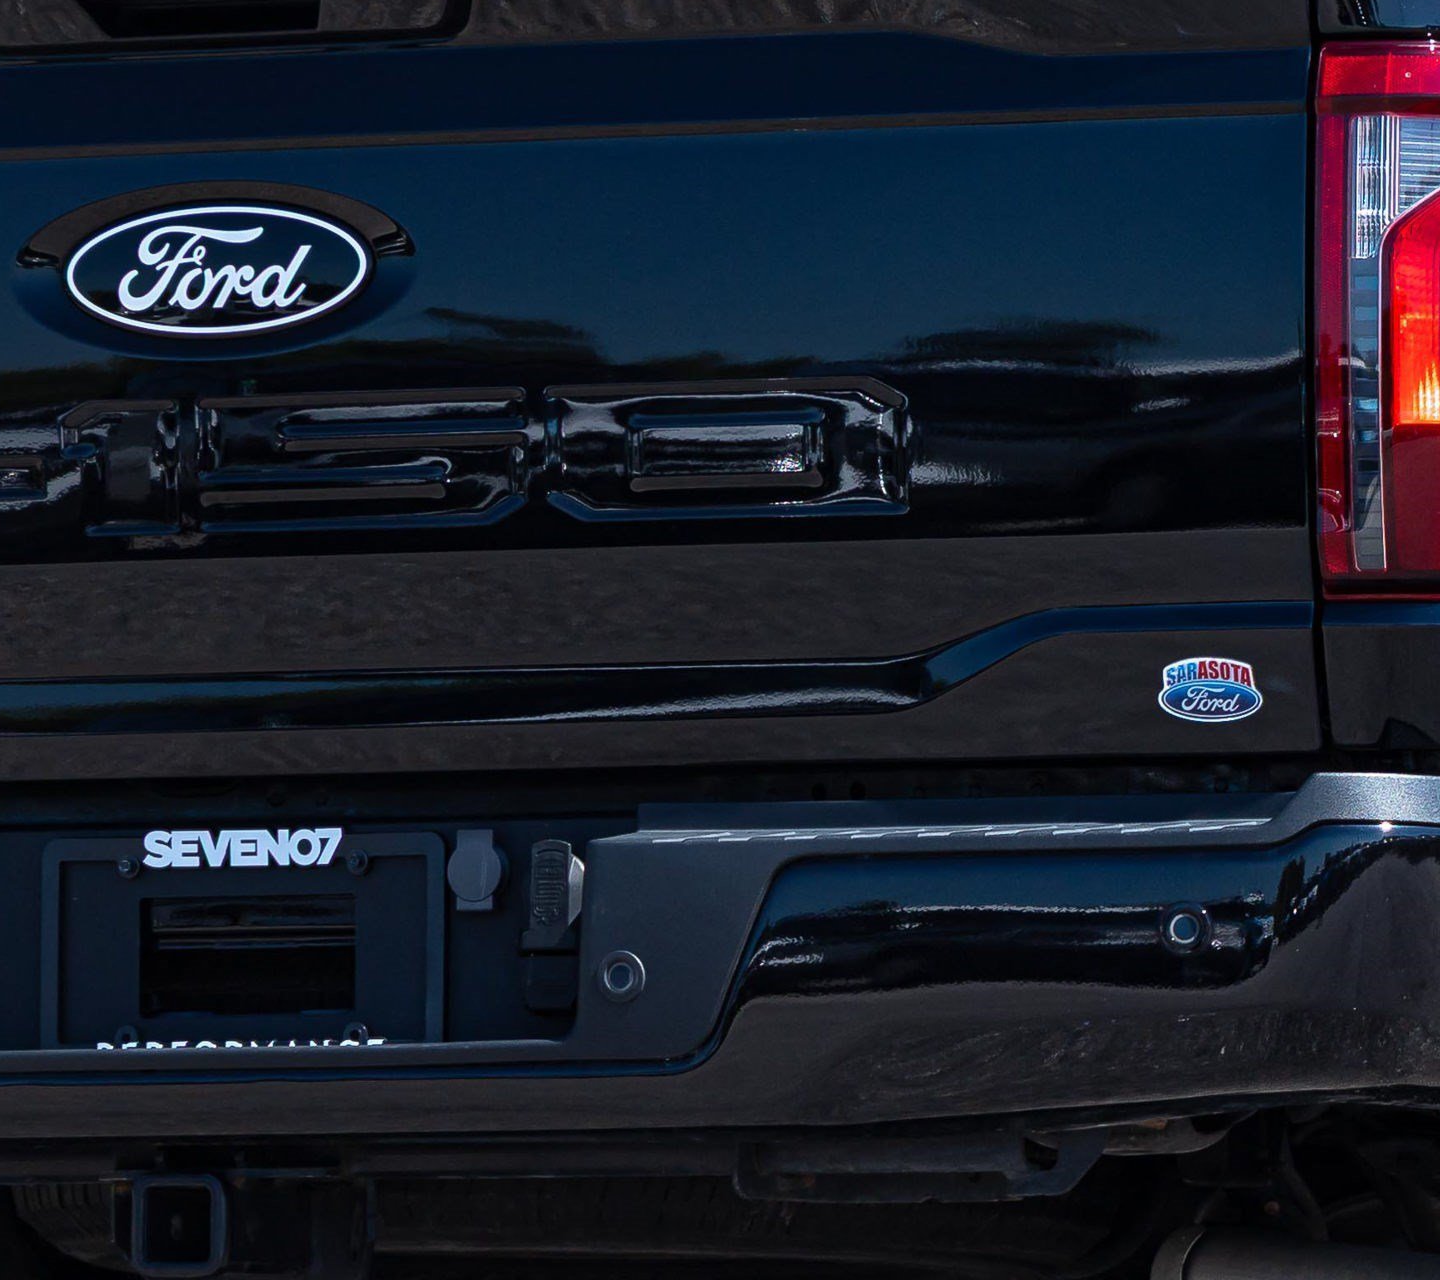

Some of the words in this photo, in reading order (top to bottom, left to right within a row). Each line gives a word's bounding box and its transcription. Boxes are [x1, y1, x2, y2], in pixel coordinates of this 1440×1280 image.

[119, 225, 312, 312] Ford
[1166, 660, 1252, 688] SARASOTA
[1181, 686, 1239, 712] Ford
